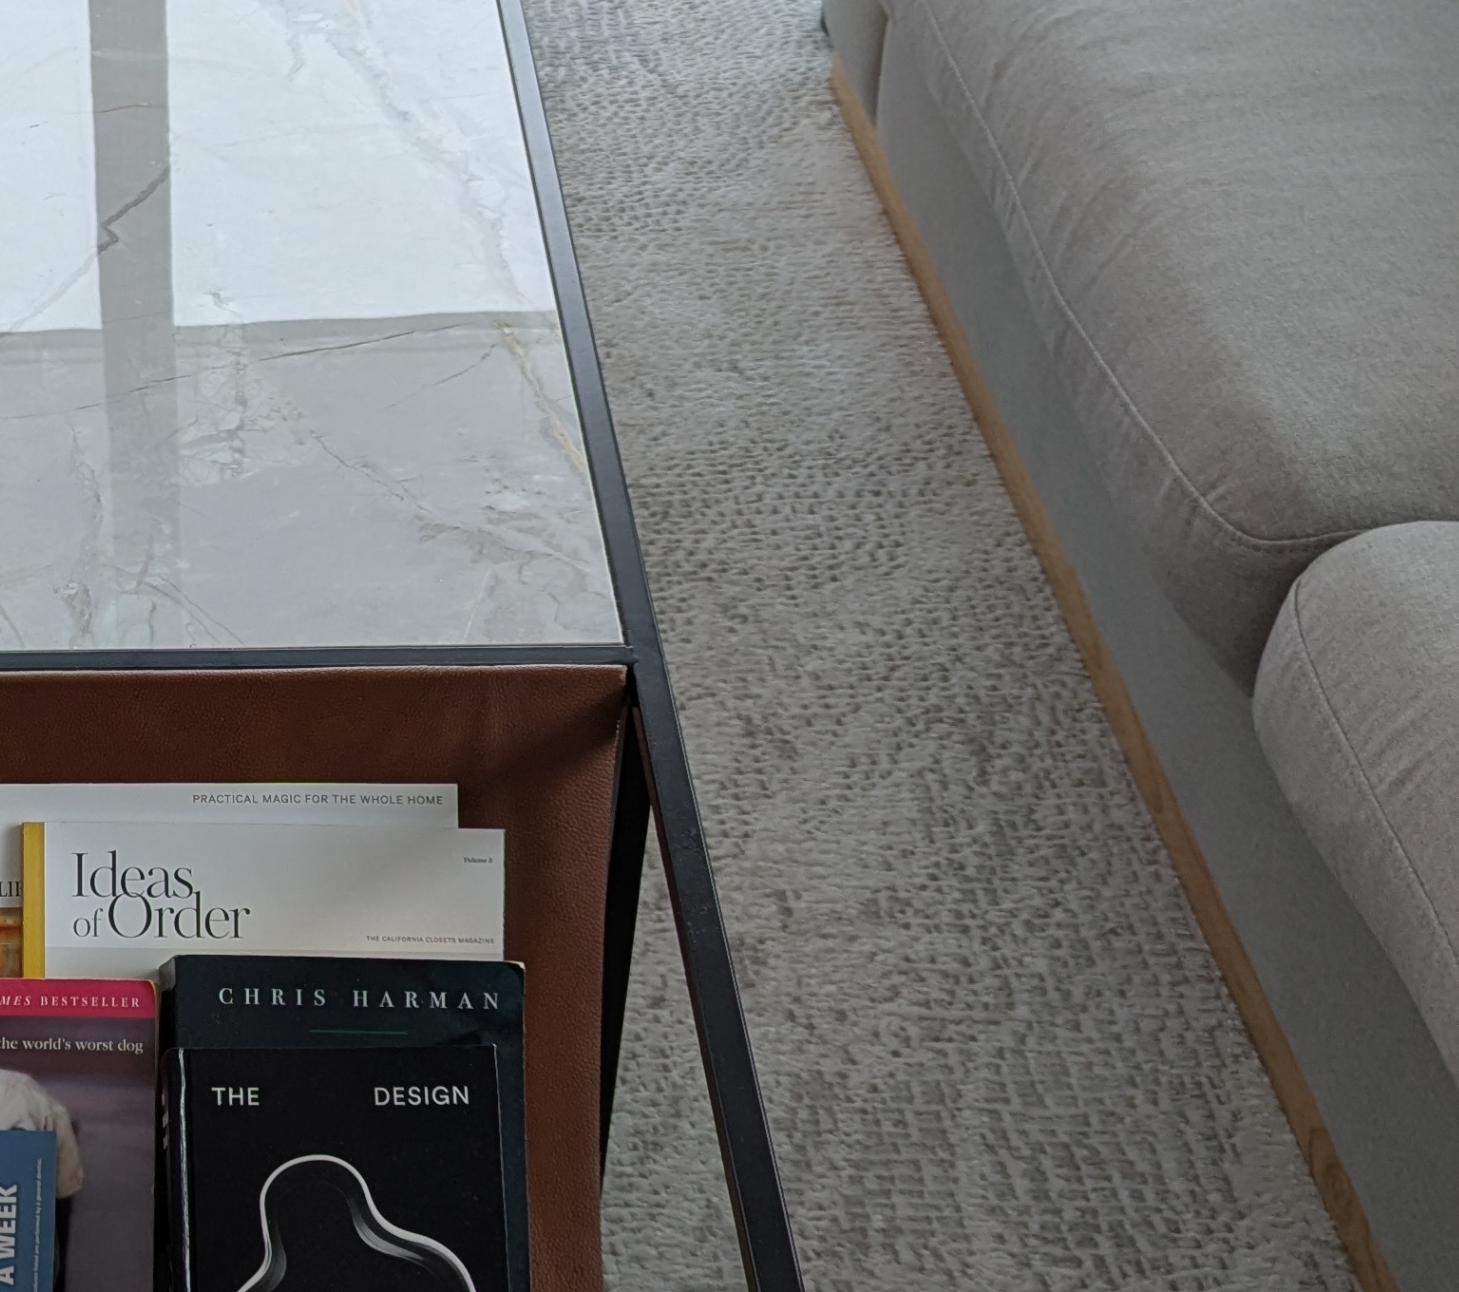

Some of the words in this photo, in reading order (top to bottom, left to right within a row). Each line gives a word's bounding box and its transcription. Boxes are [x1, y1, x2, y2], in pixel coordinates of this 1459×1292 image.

[192, 794, 258, 805] PRACTICAL
[262, 794, 301, 805] MAGIC
[305, 794, 328, 805] FOR
[332, 794, 356, 805] THE
[360, 794, 403, 805] WHOLE
[407, 795, 444, 806] HOME
[71, 850, 194, 898] Ideas
[73, 908, 103, 938] of
[108, 890, 250, 939] Order
[40, 996, 140, 1008] BESTSELLER
[218, 988, 326, 1006] CHRIS
[352, 990, 499, 1009] HARMAN
[22, 1037, 72, 1051] world's
[74, 1039, 114, 1052] worst
[117, 1039, 144, 1055] dog
[211, 1086, 260, 1106] THE
[373, 1086, 470, 1106] DESIGN
